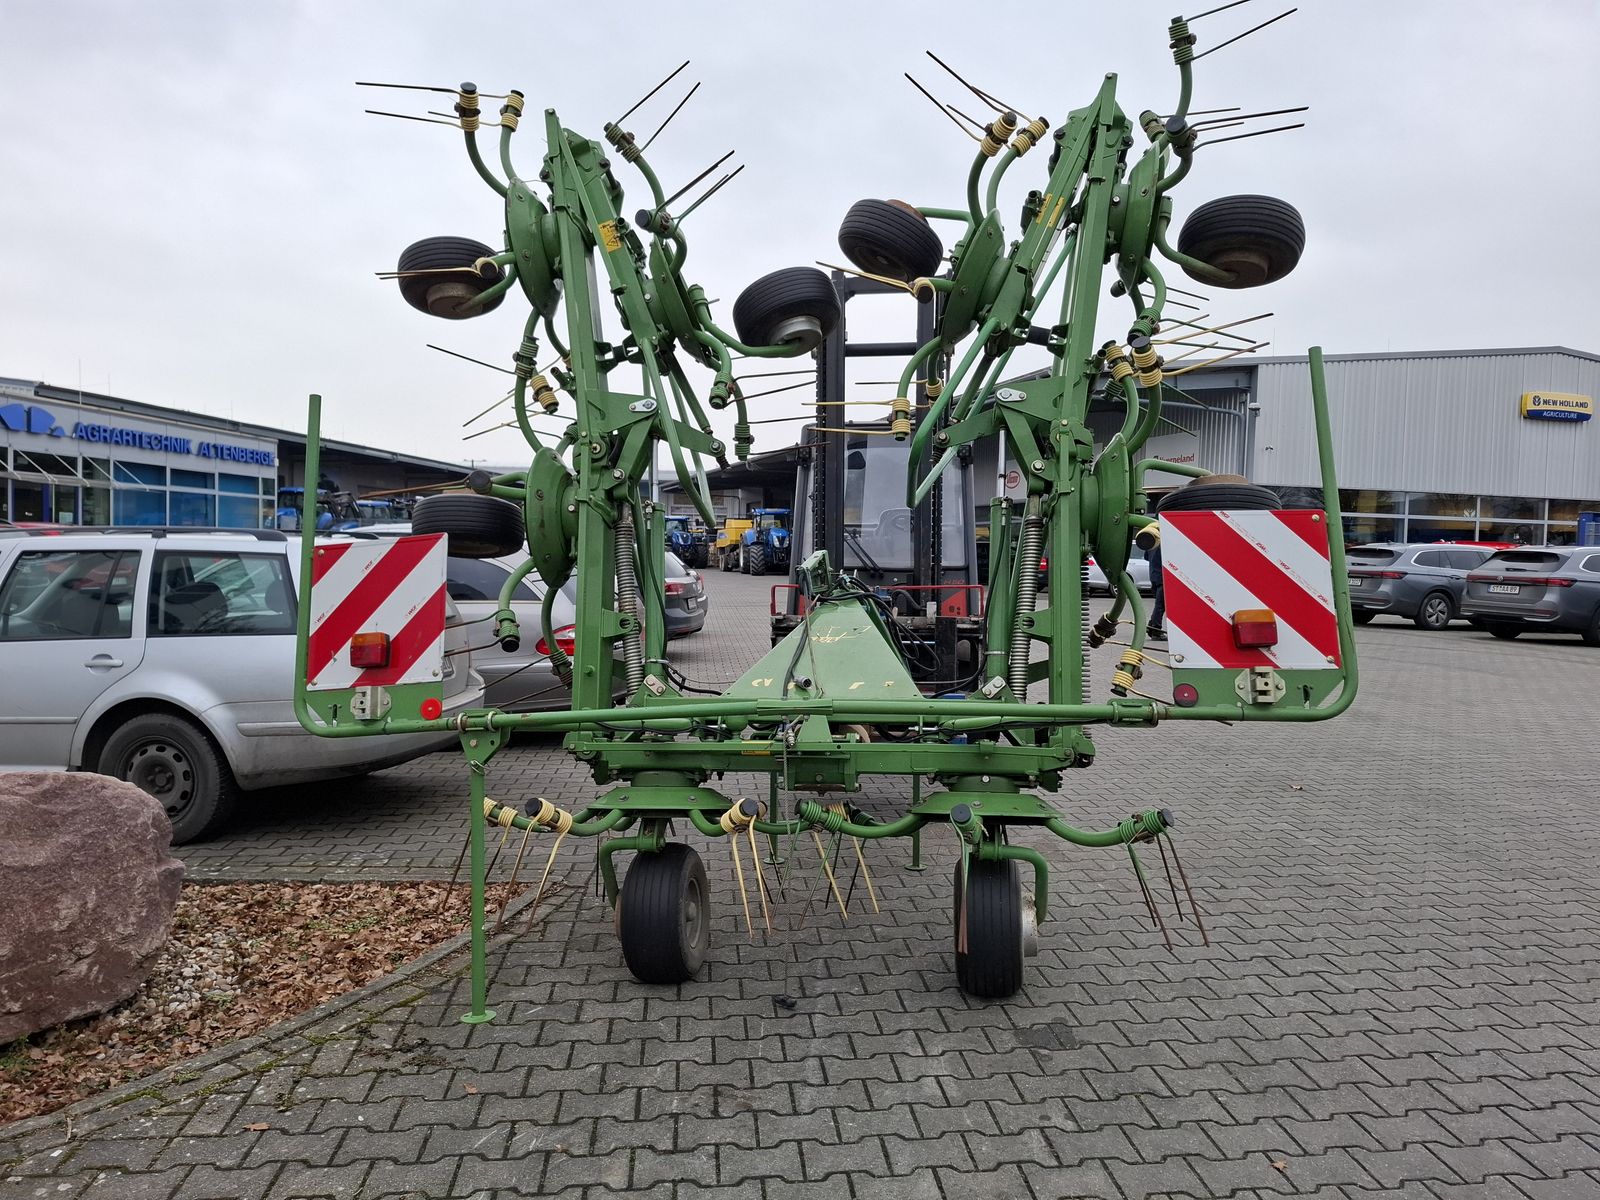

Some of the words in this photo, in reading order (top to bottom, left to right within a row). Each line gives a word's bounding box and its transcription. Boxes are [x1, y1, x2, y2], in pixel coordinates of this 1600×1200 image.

[1542, 398, 1558, 406] NEW
[1558, 399, 1589, 409] HOLLAND
[1542, 410, 1577, 419] AGRICULTURE
[74, 422, 194, 455] AGRARTECHNIK
[197, 441, 276, 467] ALTENBERGE
